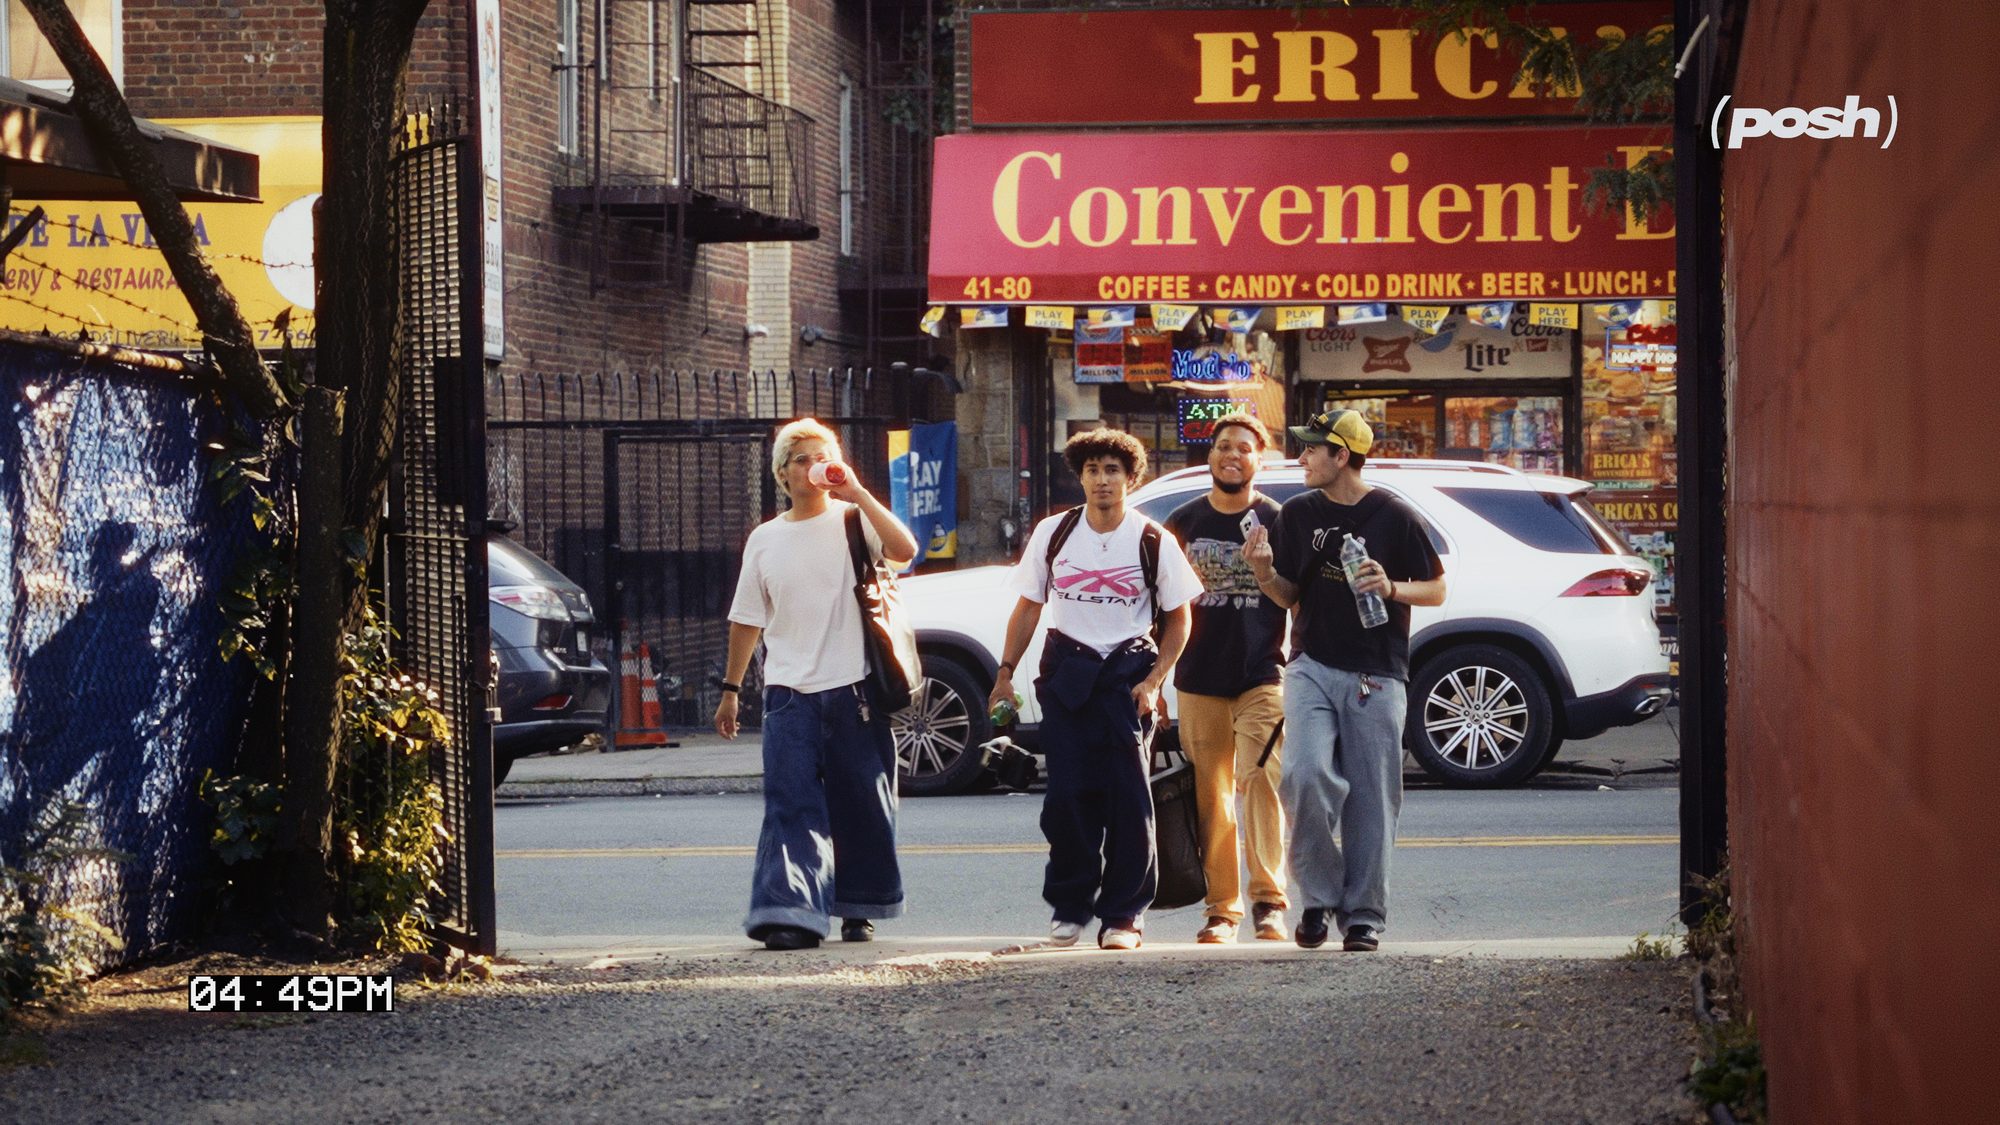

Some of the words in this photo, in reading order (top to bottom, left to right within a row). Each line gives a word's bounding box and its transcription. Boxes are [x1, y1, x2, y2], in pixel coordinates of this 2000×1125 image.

[992, 150, 1581, 249] Convenient
[67, 214, 110, 247] LA
[3, 268, 43, 296] ERY
[50, 268, 62, 291] &
[76, 267, 180, 290] RESTAURA
[963, 276, 1032, 300] 41-80
[1098, 275, 1190, 300] COFFEE
[1215, 274, 1297, 299] CANDY
[1316, 273, 1380, 299] COLD
[1386, 272, 1463, 298] DRINK
[1482, 272, 1545, 296] BEER
[1565, 270, 1647, 296] LUNCH
[1158, 308, 1189, 317] PLAY
[1284, 310, 1314, 318] PLAY
[1410, 309, 1439, 318] PLAY
[1538, 307, 1568, 316] PLAY
[1311, 341, 1352, 352] LIGHT
[1464, 342, 1511, 373] Lite
[1611, 351, 1654, 364] HAPPY
[1655, 351, 1677, 365] HO
[1186, 403, 1246, 420] ATM
[1593, 453, 1650, 469] ERICA'S
